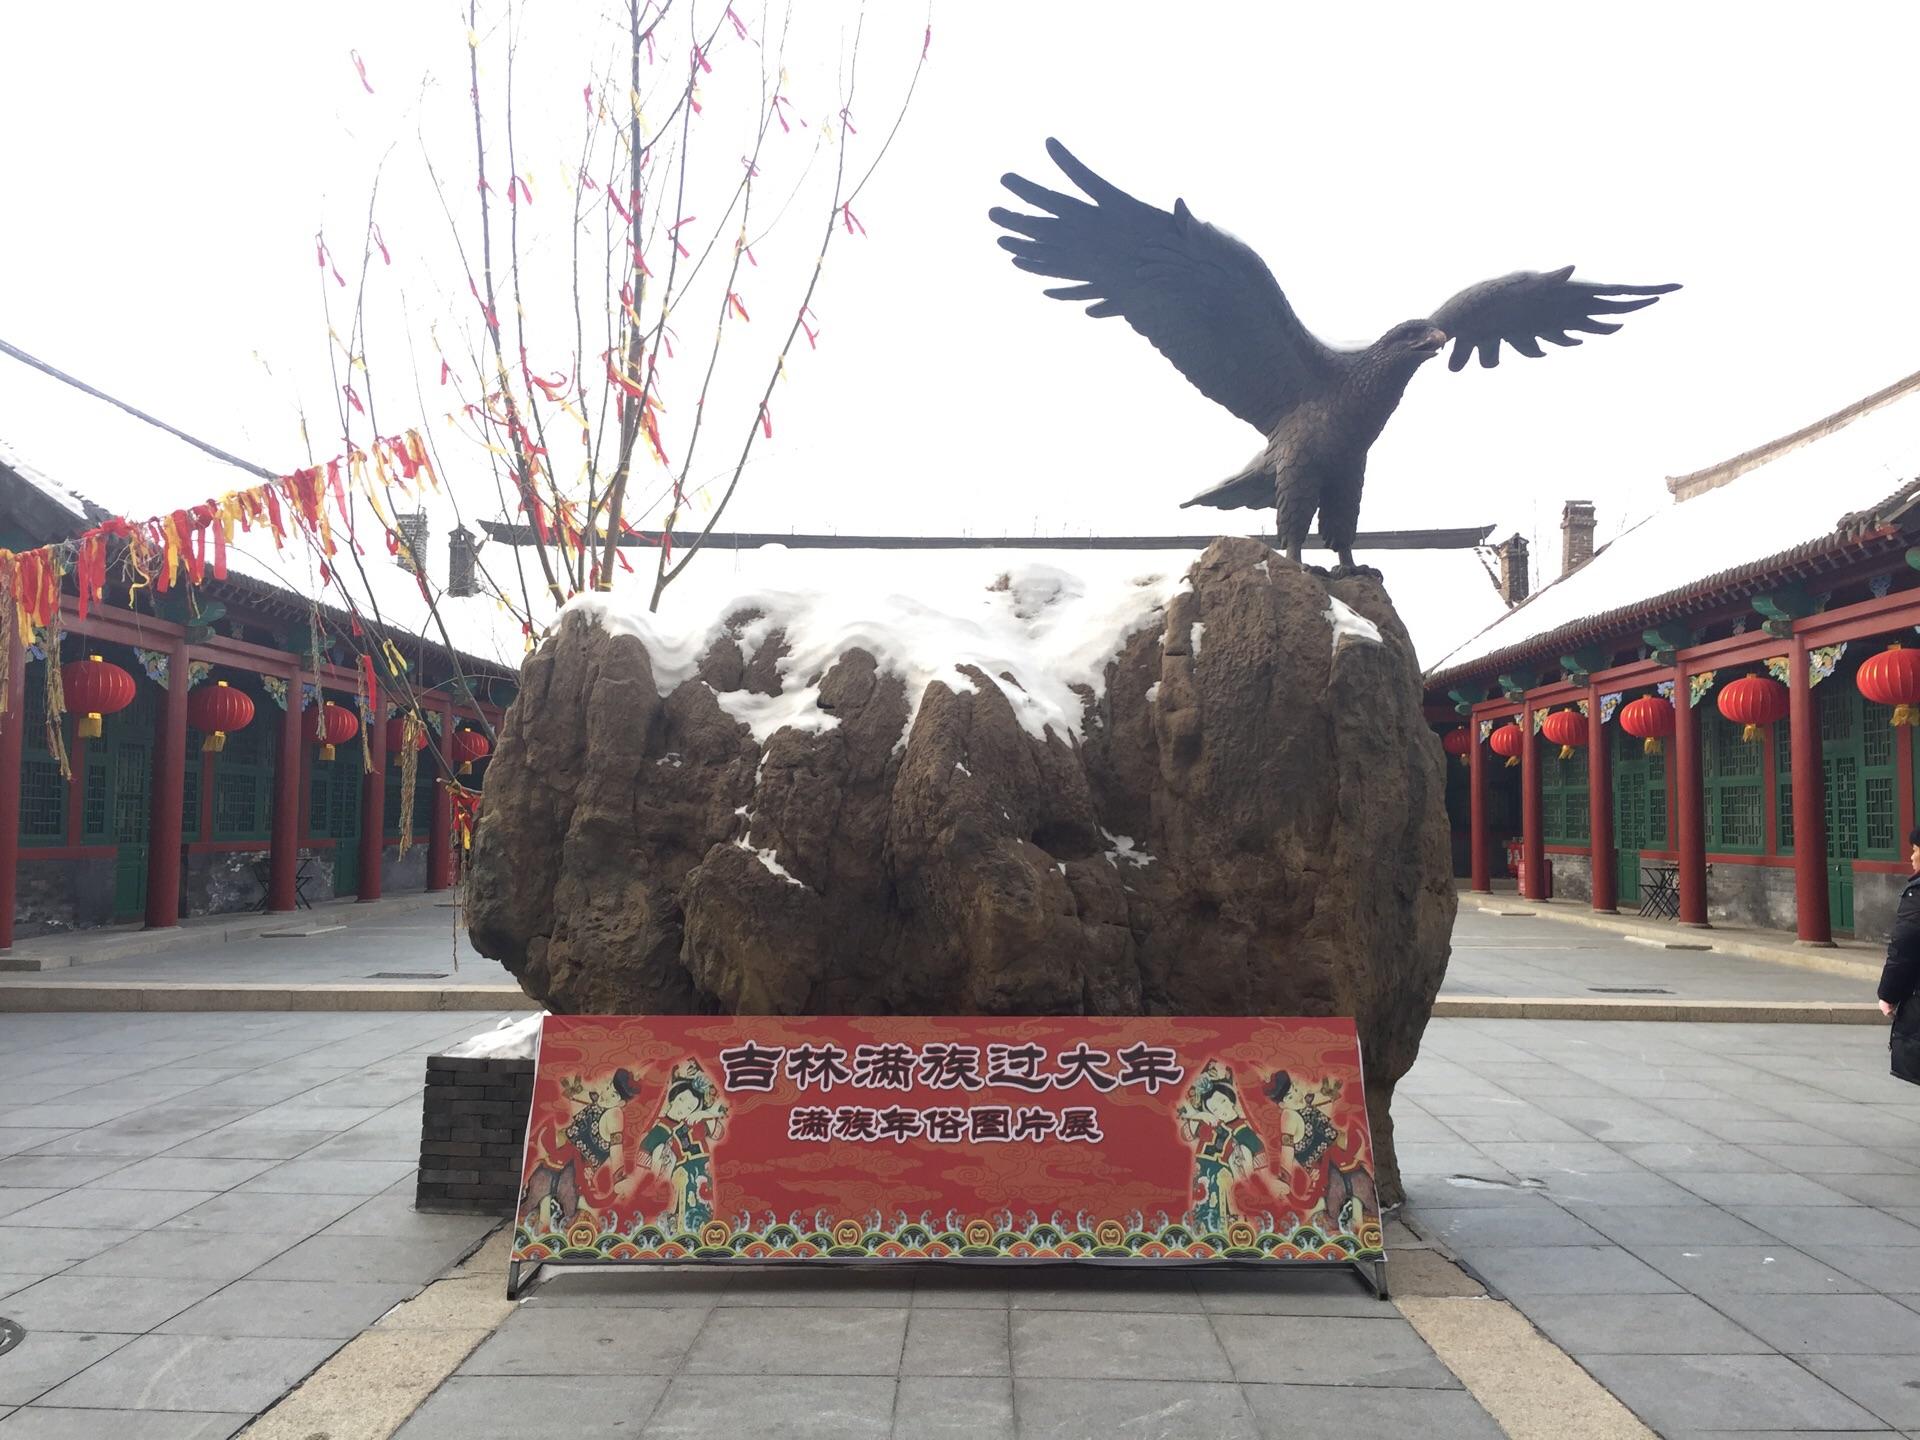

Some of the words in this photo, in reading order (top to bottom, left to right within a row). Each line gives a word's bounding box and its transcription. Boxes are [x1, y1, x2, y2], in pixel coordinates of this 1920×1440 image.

[720, 1040, 1184, 1094] 吉林满族过大年
[788, 1104, 1104, 1143] 满族年俗图片展
